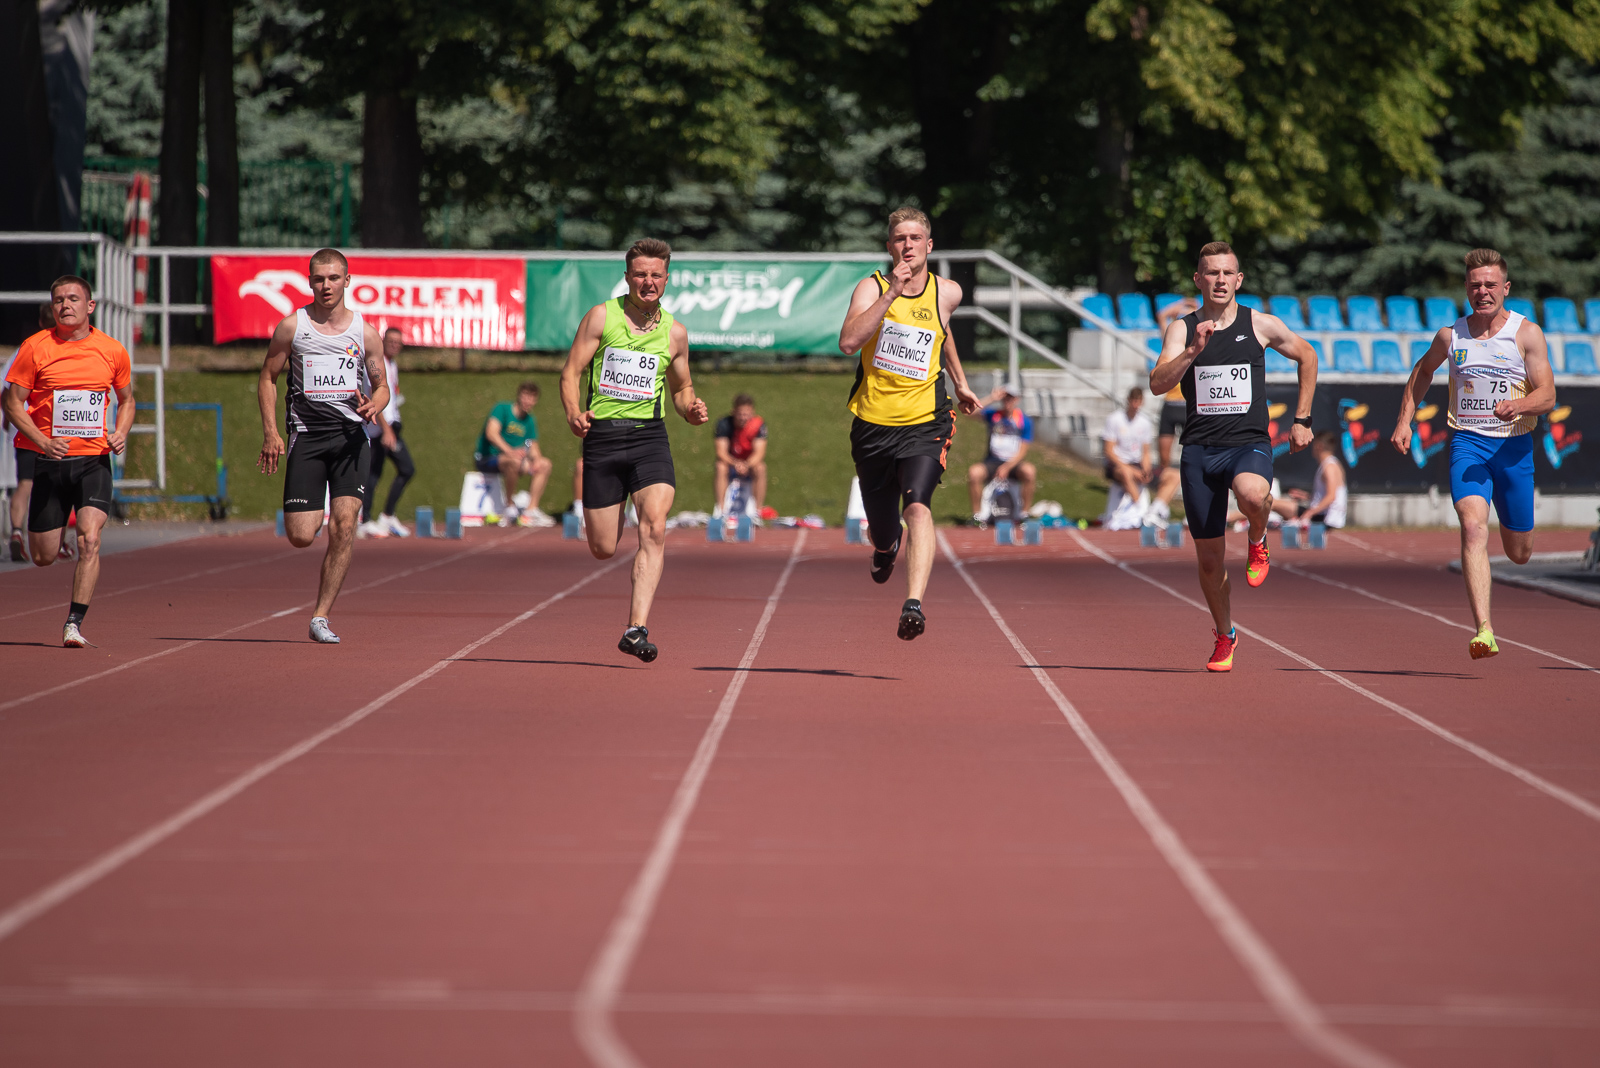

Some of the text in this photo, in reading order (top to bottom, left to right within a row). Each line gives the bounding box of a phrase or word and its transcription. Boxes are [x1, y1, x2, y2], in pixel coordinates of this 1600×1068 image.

[671, 269, 769, 288] INTER
[352, 284, 483, 308] ORLEN
[611, 276, 804, 331] uropol
[916, 331, 932, 346] 79
[881, 341, 926, 363] LINIEWICZ
[338, 357, 355, 370] 76
[639, 356, 655, 370] 85
[876, 360, 905, 374] WARSZAWA
[905, 369, 919, 377] 2022
[313, 375, 346, 387] HAŁA
[603, 369, 652, 389] PACIOREK
[1230, 367, 1248, 381] 90
[602, 387, 631, 399] WARSZAWA
[1209, 386, 1237, 399] SZAL
[1490, 381, 1508, 394] 75
[89, 393, 103, 406] 89
[1460, 398, 1506, 411] GRZELA
[62, 410, 99, 422] SEWIŁO
[475, 484, 492, 510] 7
